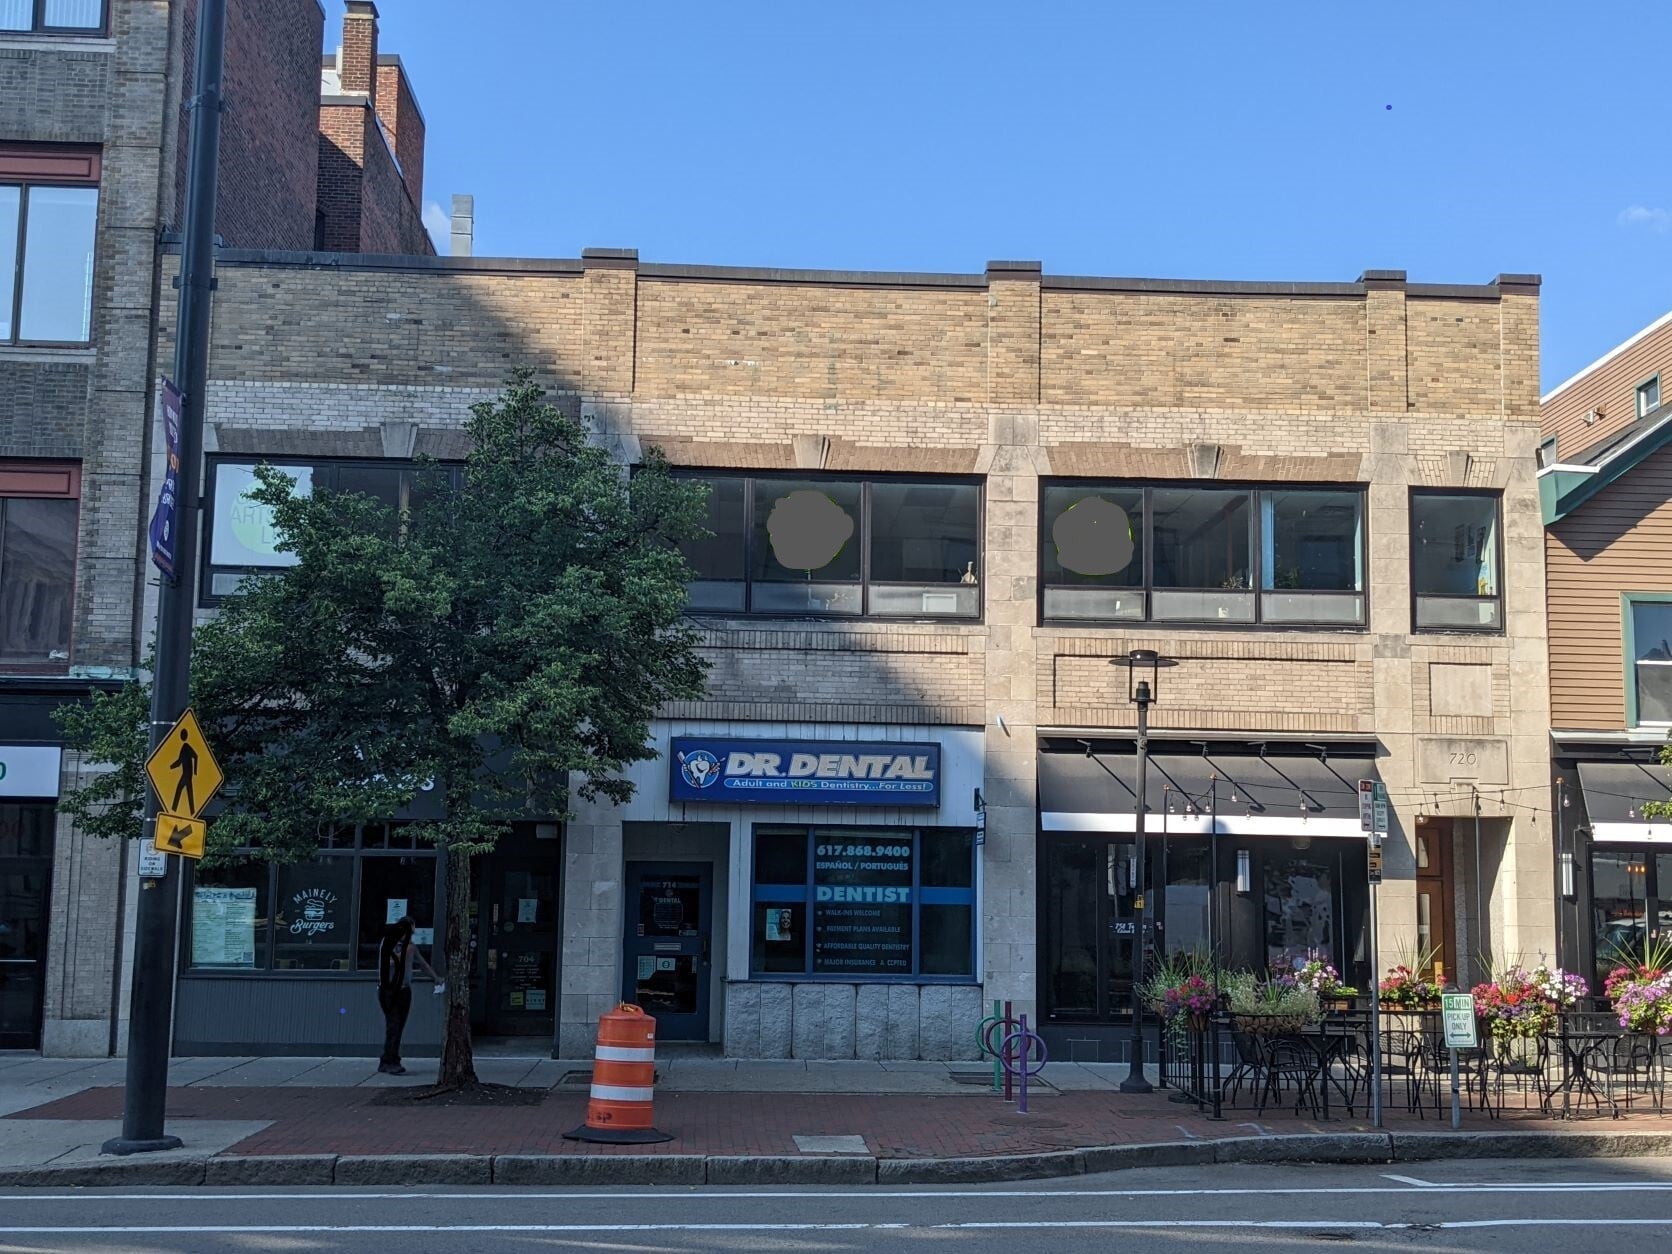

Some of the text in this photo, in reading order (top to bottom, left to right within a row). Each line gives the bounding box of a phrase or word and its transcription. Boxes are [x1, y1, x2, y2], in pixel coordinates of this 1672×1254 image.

[1449, 752, 1476, 765] 720
[788, 753, 934, 779] DENTAL
[733, 779, 763, 788] Adult
[766, 780, 787, 788] and
[790, 780, 817, 788] KIDS
[900, 782, 926, 791] Less!
[816, 845, 910, 856] 617.868.9400
[816, 861, 853, 869] ESPAÑOL
[293, 888, 338, 904] MAINELY
[816, 887, 910, 902] DENTIST
[290, 919, 335, 936] Burgers
[1445, 998, 1470, 1008] 15 MIN
[1452, 1022, 1466, 1030] ONLY
